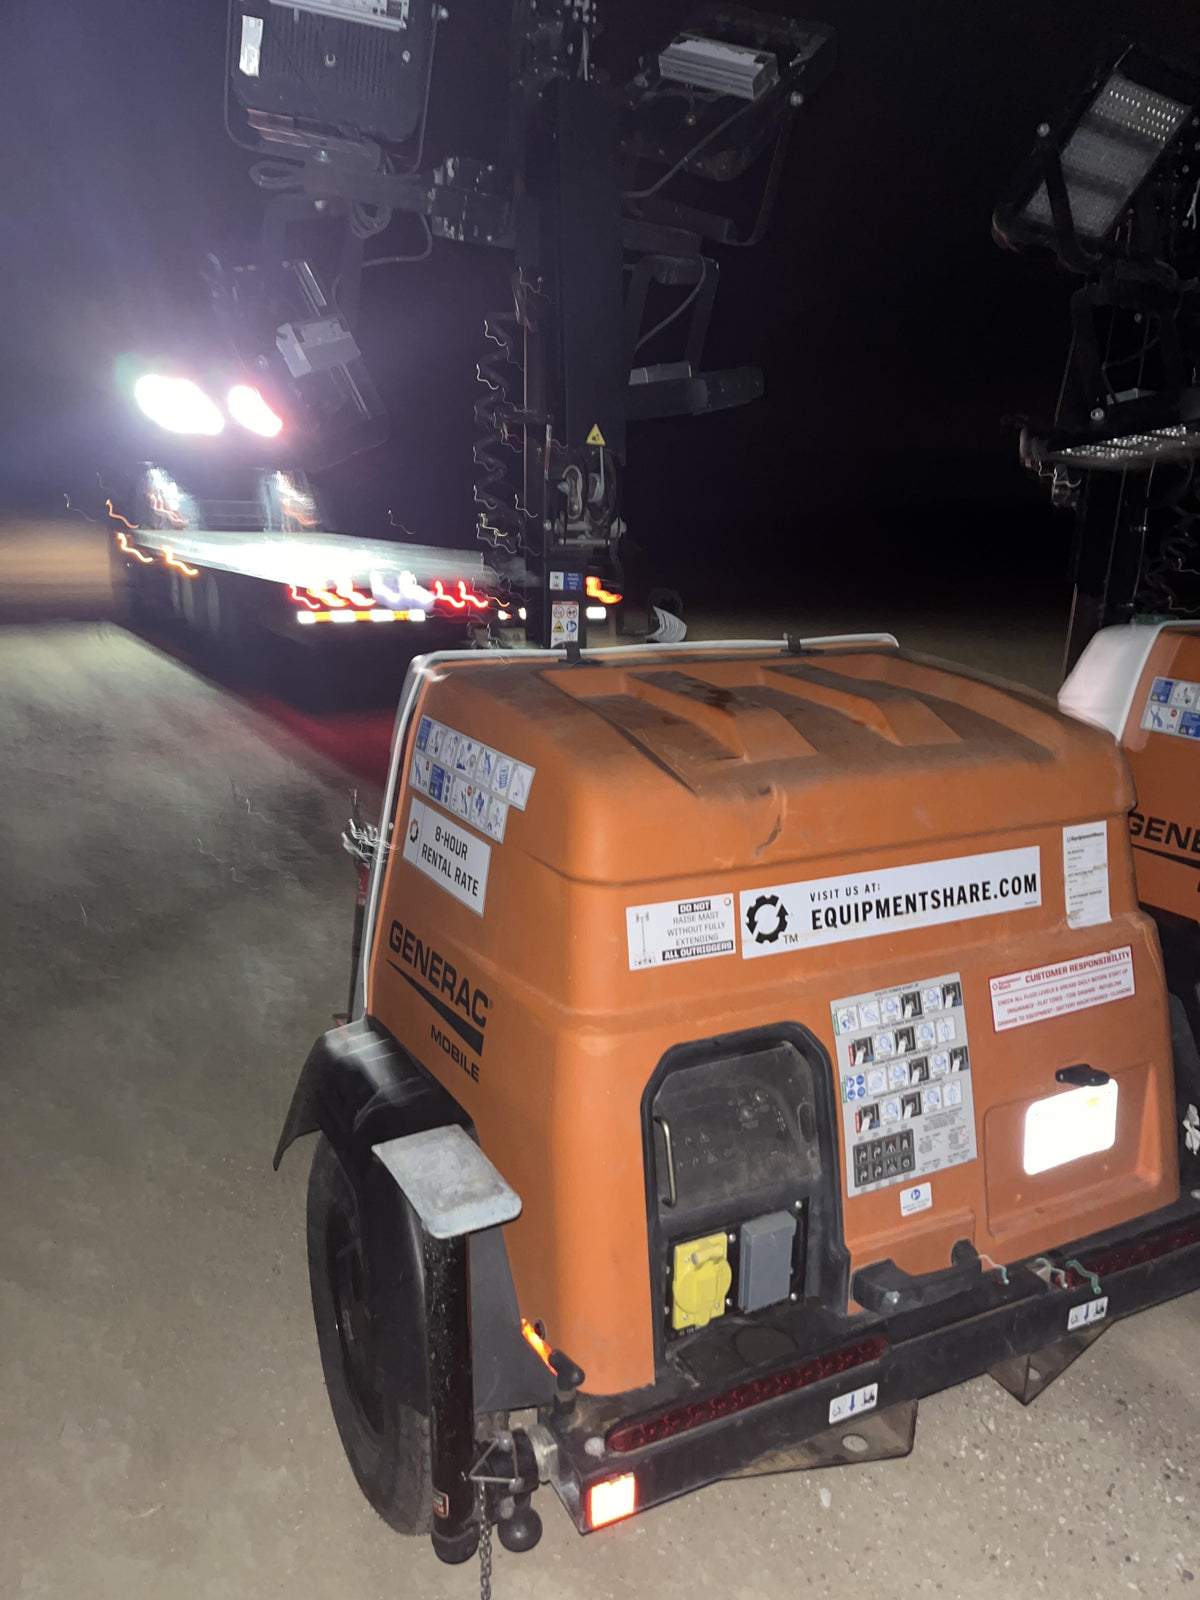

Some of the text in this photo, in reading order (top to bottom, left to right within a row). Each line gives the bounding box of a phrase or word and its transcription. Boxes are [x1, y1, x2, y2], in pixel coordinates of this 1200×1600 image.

[434, 824, 468, 861] 8-HOUR
[421, 843, 479, 897] RENTAL RATE
[809, 882, 881, 902] VISIT US AT:
[810, 873, 1038, 931] EQUIPMENTSHARE.COM
[679, 901, 711, 914] DO NOT
[673, 911, 719, 925] RAISE MAST
[667, 921, 726, 937] WITHOUT FULLY
[782, 933, 799, 944] TM
[675, 933, 719, 946] EXTENDING
[664, 941, 732, 961] ALL OUTRIGGERS
[389, 919, 489, 1029] GENERAC
[1025, 951, 1130, 984] CUSTOMER RESPONSIBILITY
[430, 1024, 480, 1083] MOBILE
